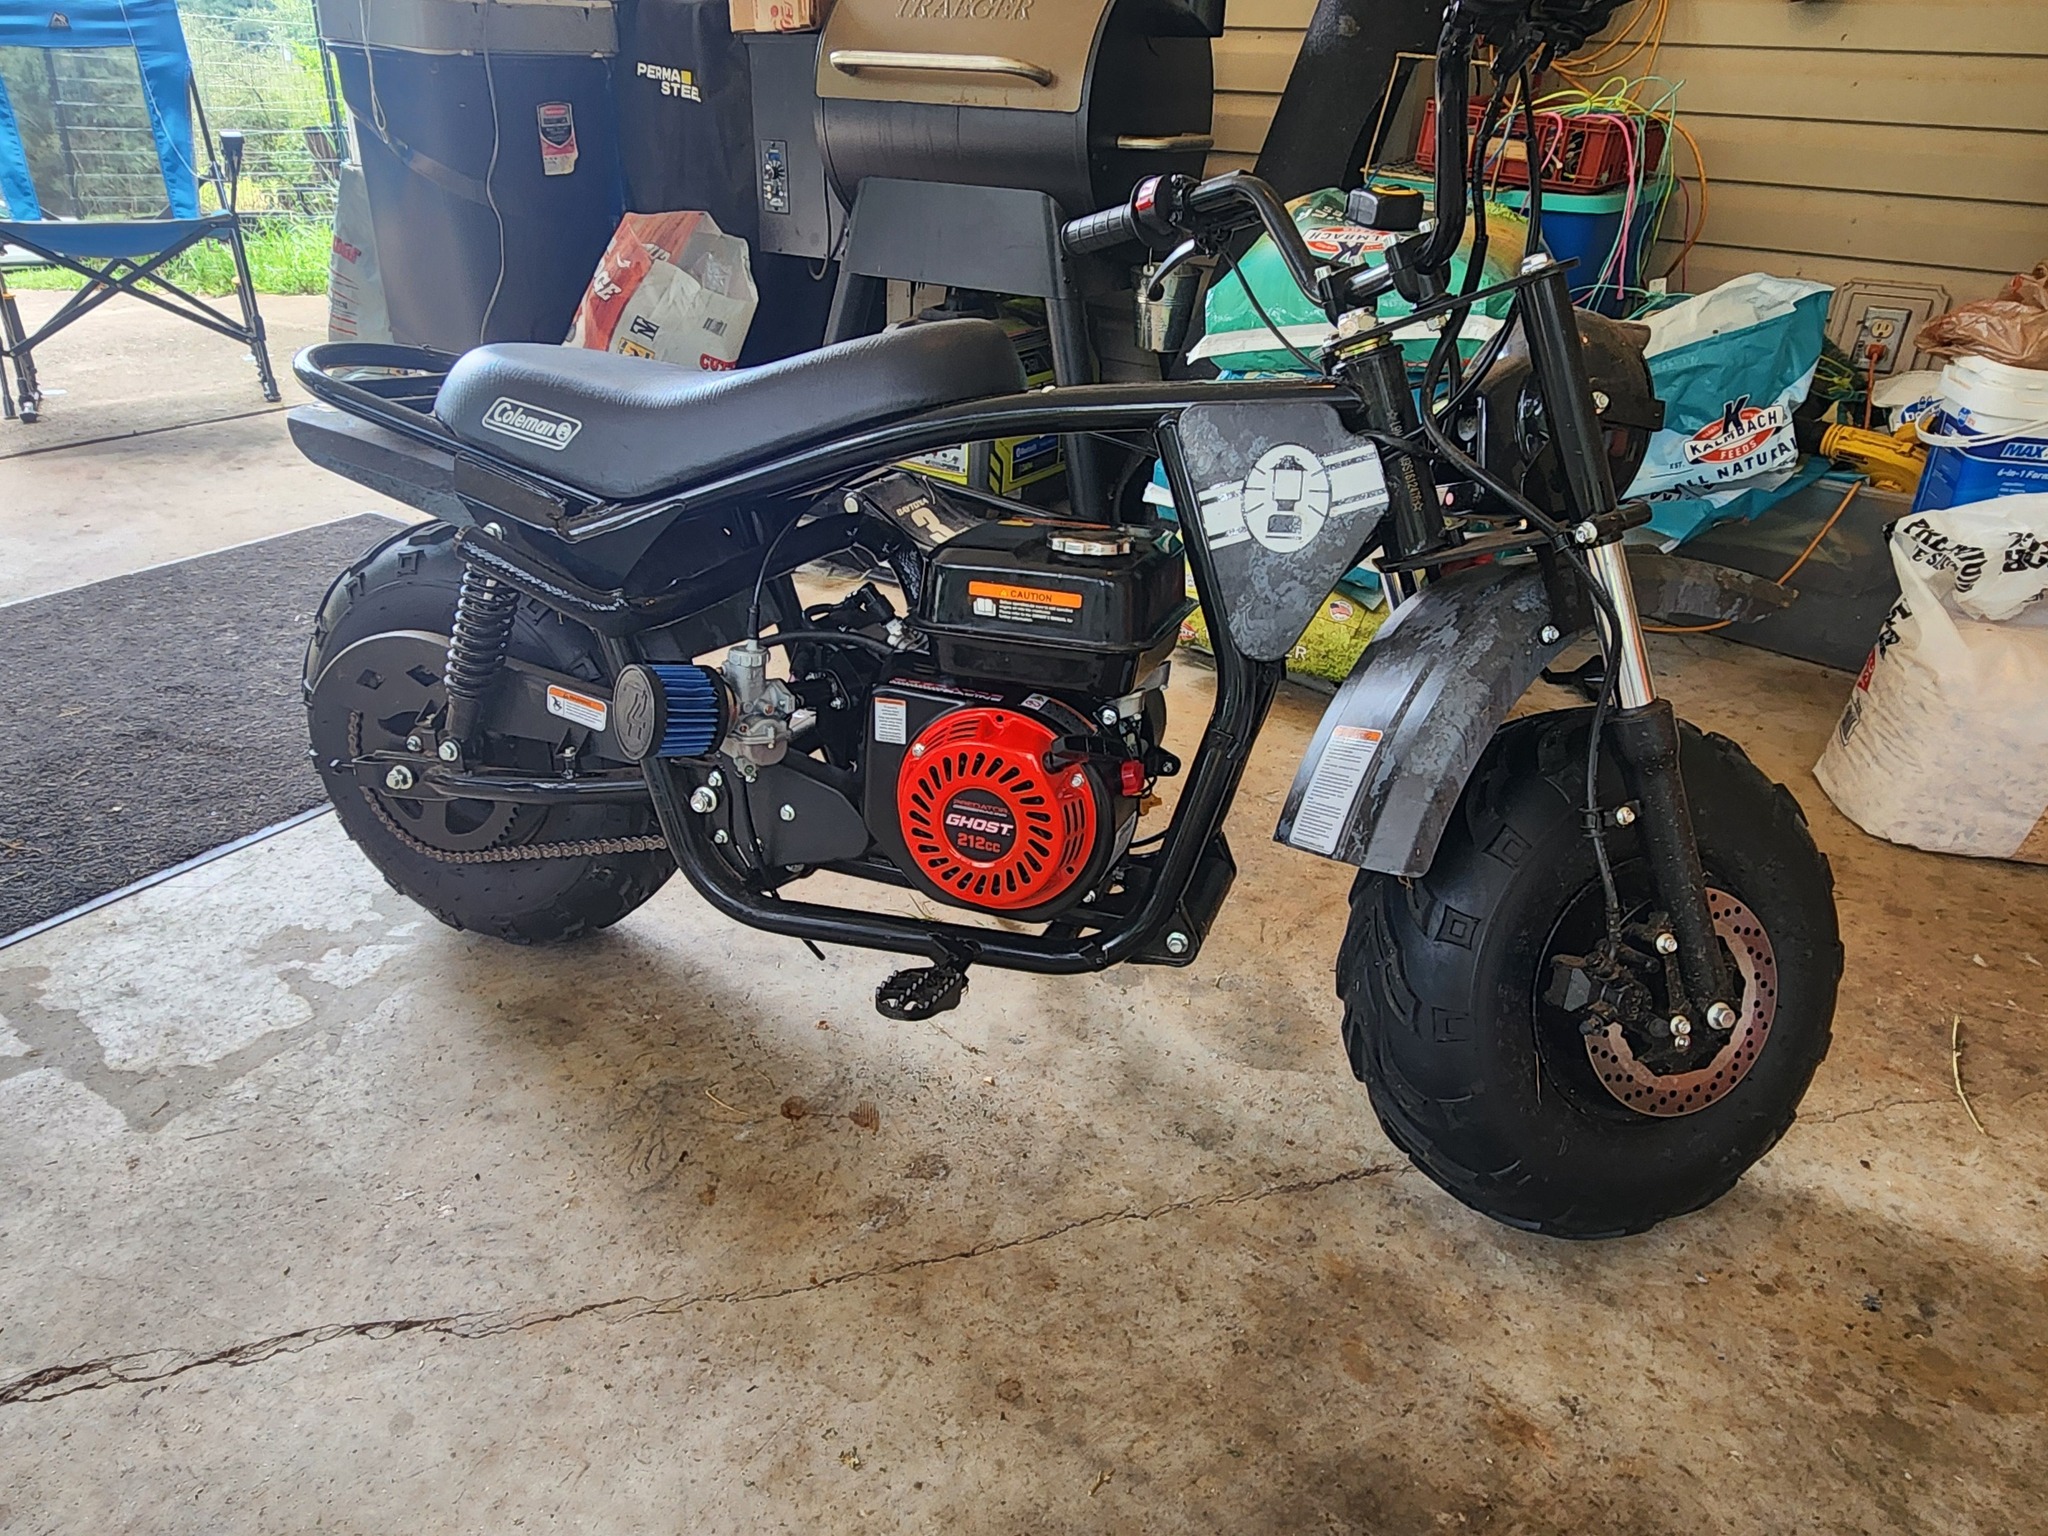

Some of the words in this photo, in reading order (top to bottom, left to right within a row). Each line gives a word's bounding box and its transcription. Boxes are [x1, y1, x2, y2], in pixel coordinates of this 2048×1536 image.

[636, 61, 681, 82] PERMA
[493, 402, 558, 437] Coleman
[1689, 410, 1778, 456] KALMBACH
[1719, 440, 1758, 461] FEEDS
[2003, 443, 2043, 459] MAX
[1010, 589, 1053, 603] CAUTION
[945, 813, 1014, 837] GHOST
